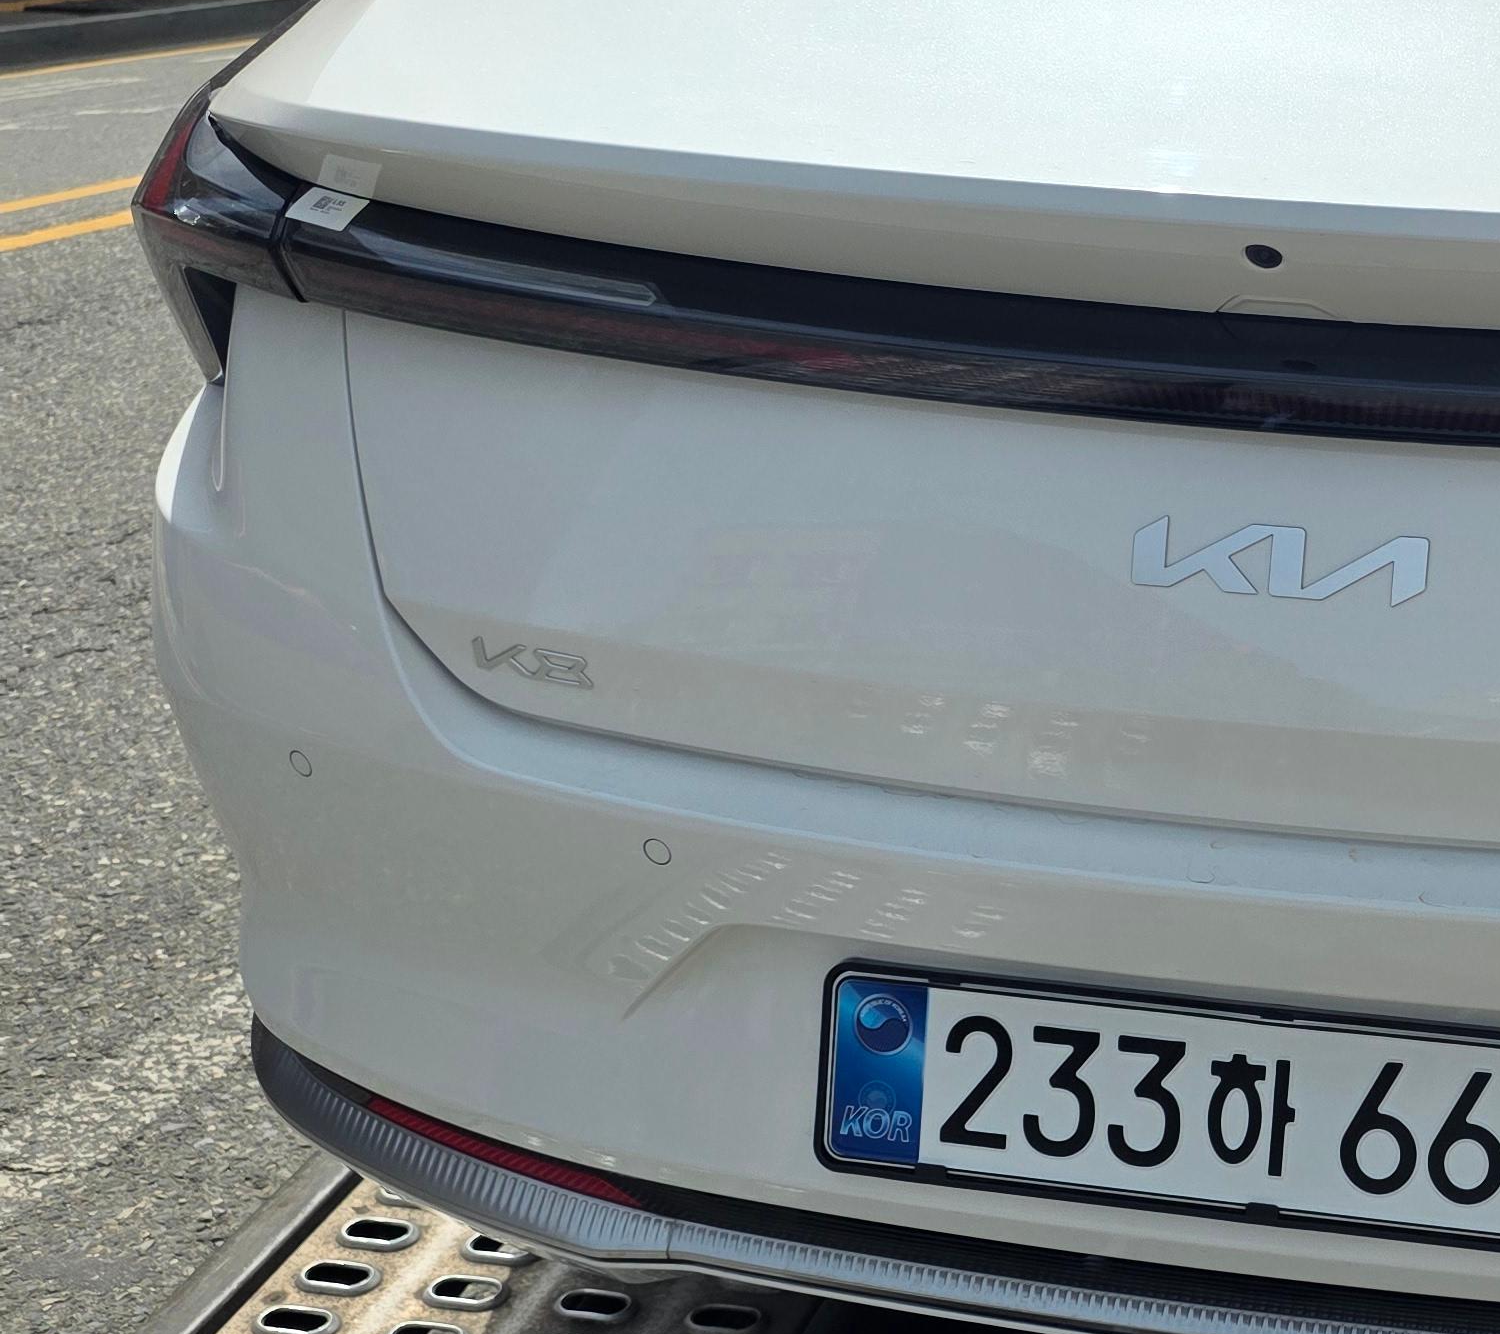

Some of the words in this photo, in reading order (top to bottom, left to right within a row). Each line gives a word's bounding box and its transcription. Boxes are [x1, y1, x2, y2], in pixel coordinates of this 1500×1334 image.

[1130, 514, 1430, 608] KIA
[471, 635, 594, 689] K8
[839, 1105, 913, 1143] KOR
[938, 1014, 1297, 1178] 233하
